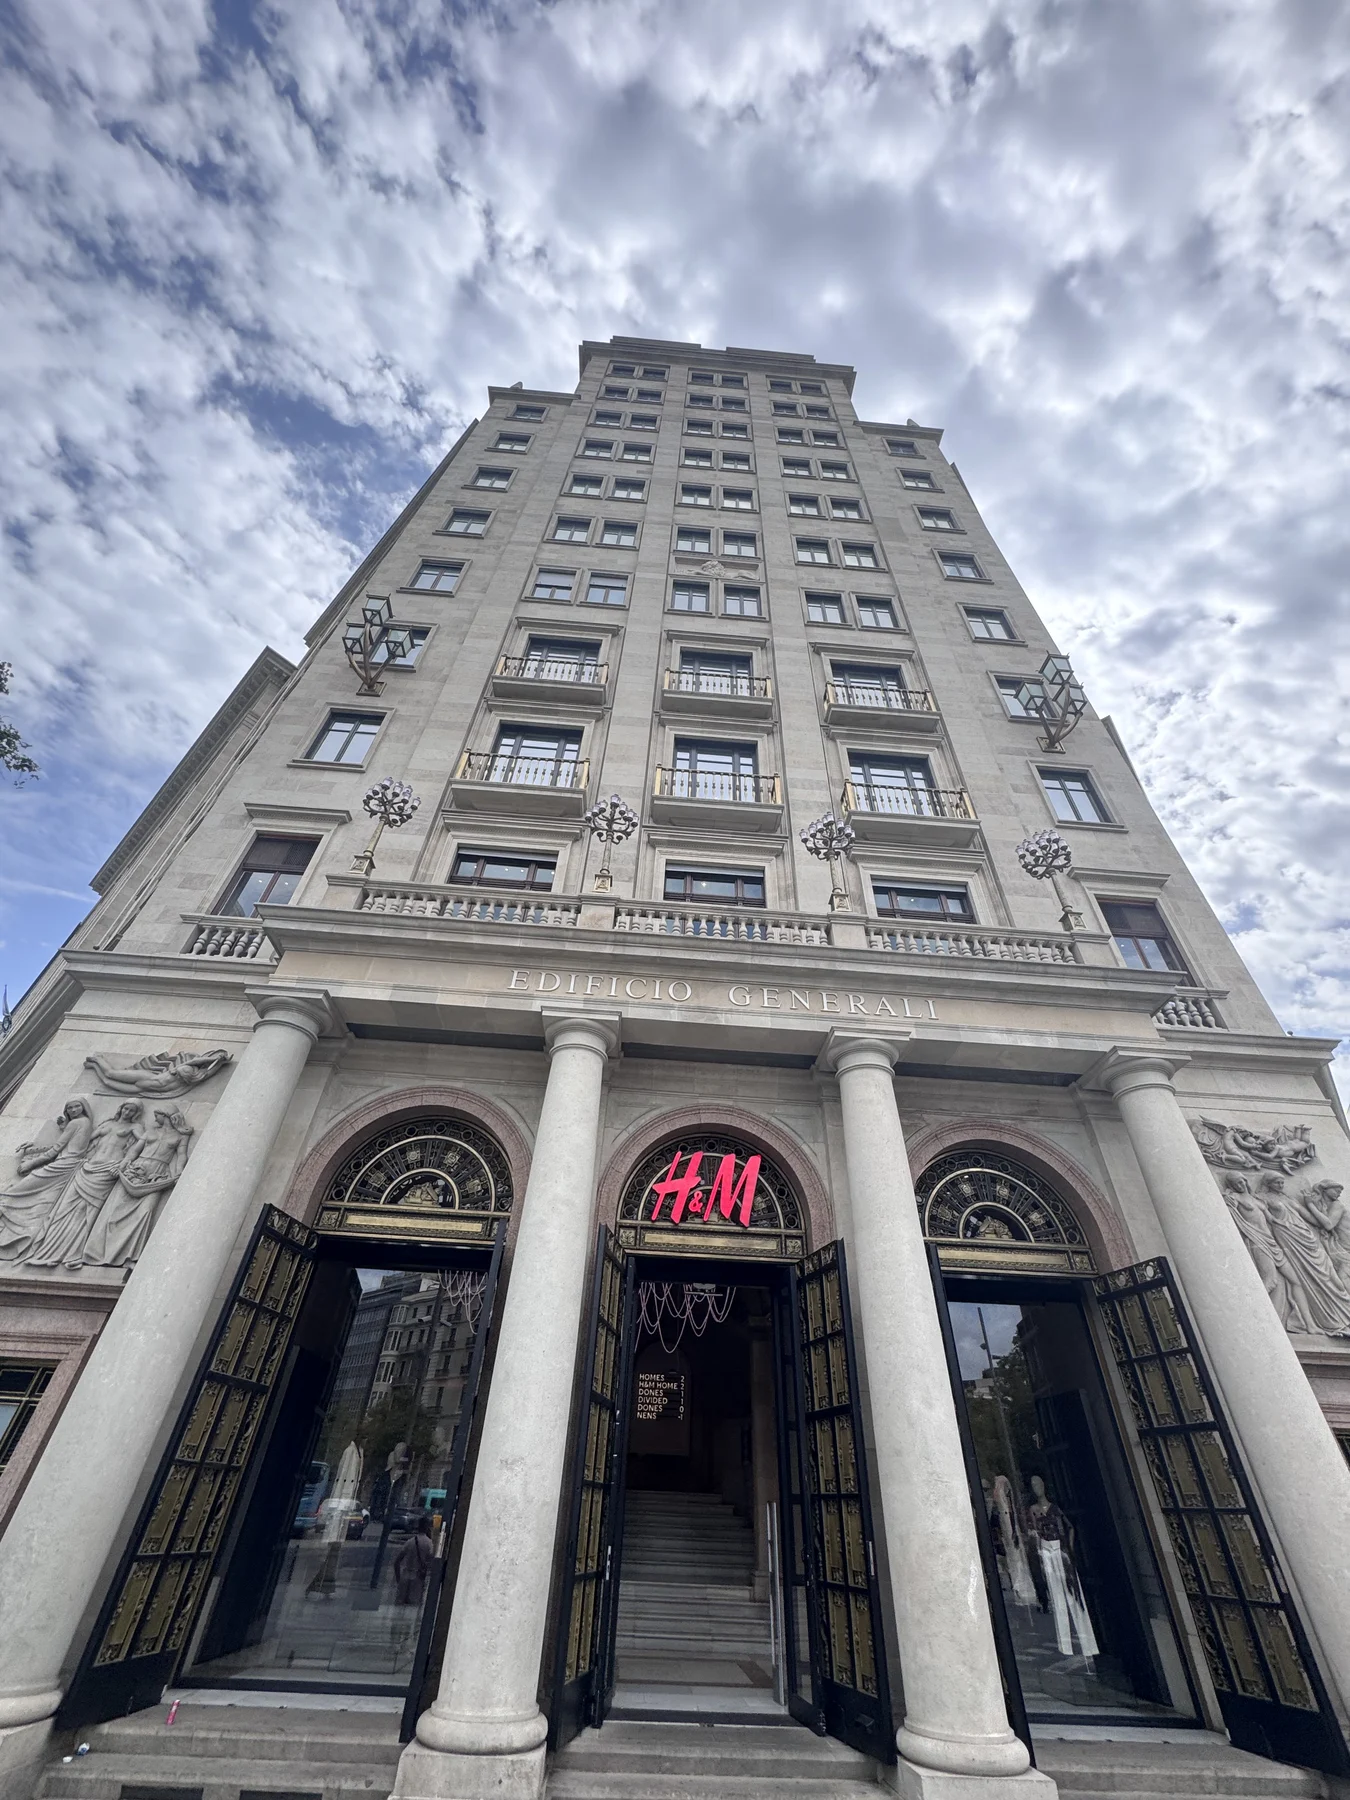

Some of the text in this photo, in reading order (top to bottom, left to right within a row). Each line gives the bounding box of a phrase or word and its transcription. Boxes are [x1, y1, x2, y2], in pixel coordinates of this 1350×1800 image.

[507, 969, 940, 1020] EDIFICIO GENERALI
[652, 1151, 762, 1228] H&M
[639, 1373, 665, 1381] HOMES
[638, 1396, 668, 1404] DIVIDED
[637, 1404, 663, 1412] DONES
